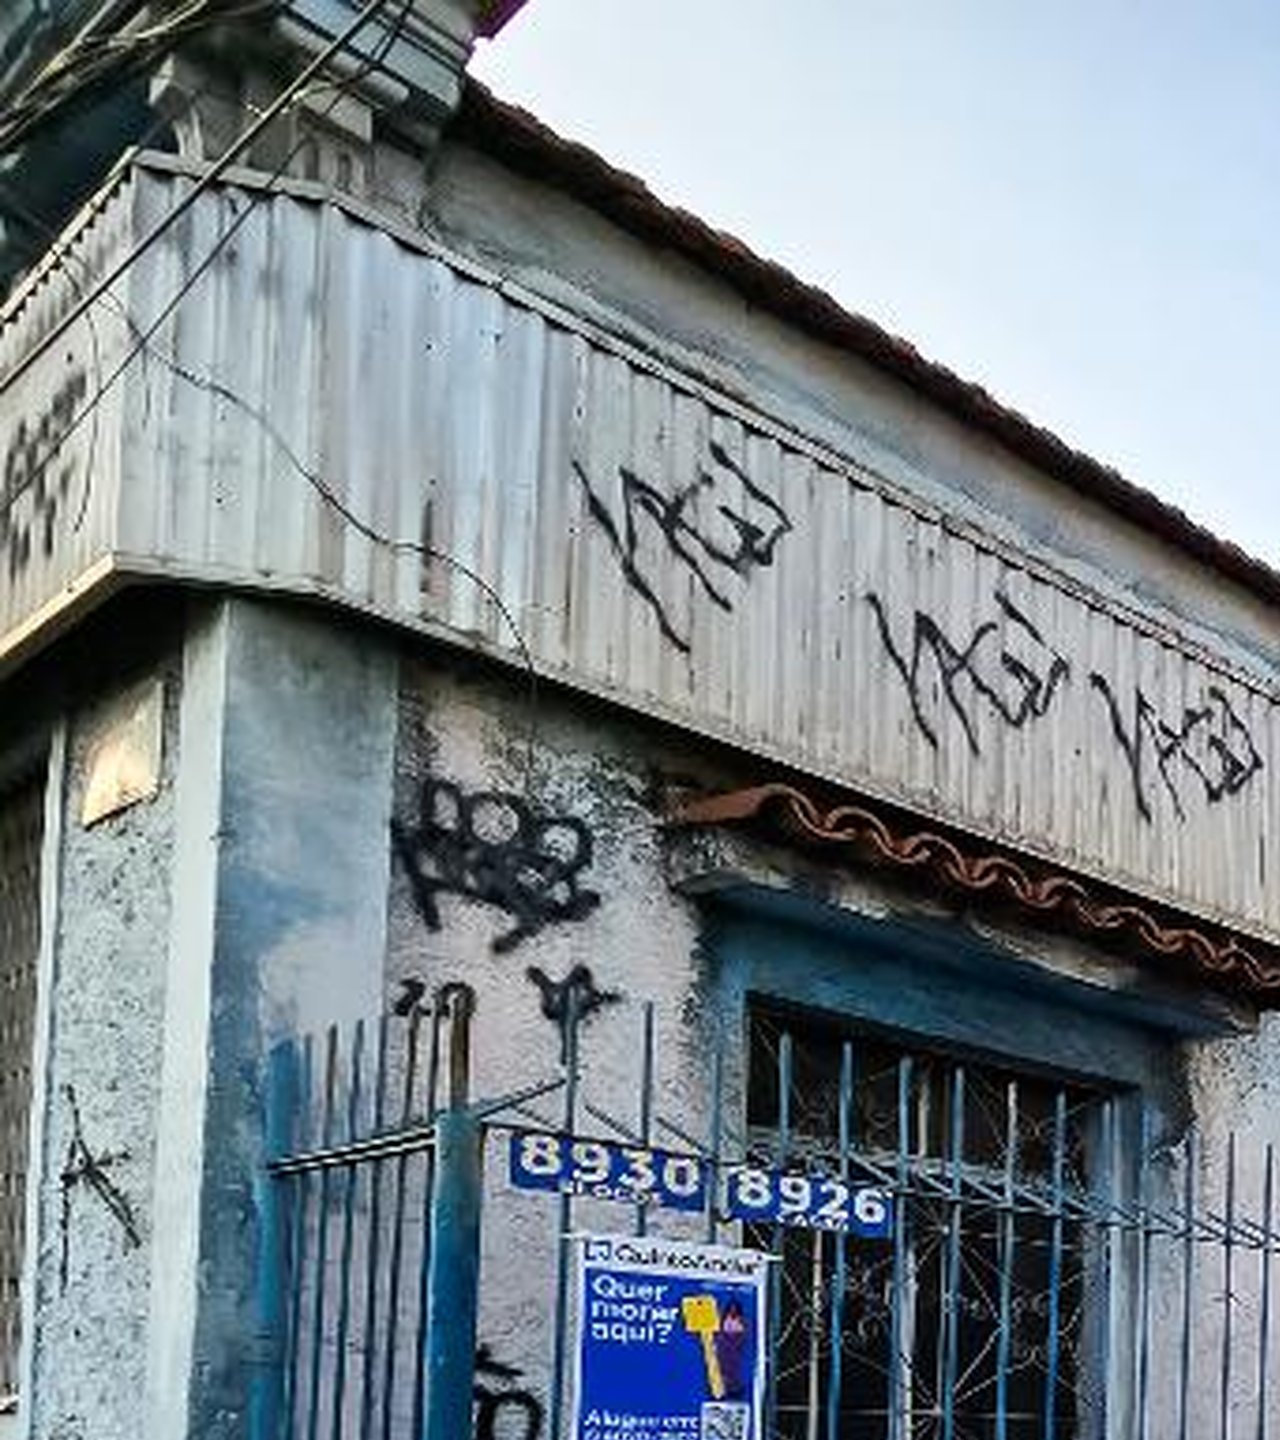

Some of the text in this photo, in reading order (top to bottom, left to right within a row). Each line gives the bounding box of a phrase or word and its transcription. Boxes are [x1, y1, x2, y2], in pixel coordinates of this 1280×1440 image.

[520, 1134, 699, 1196] 8930
[738, 1169, 886, 1223] 8926
[592, 1274, 669, 1301] Quer
[591, 1301, 678, 1321] morar
[591, 1323, 673, 1344] aqui?
